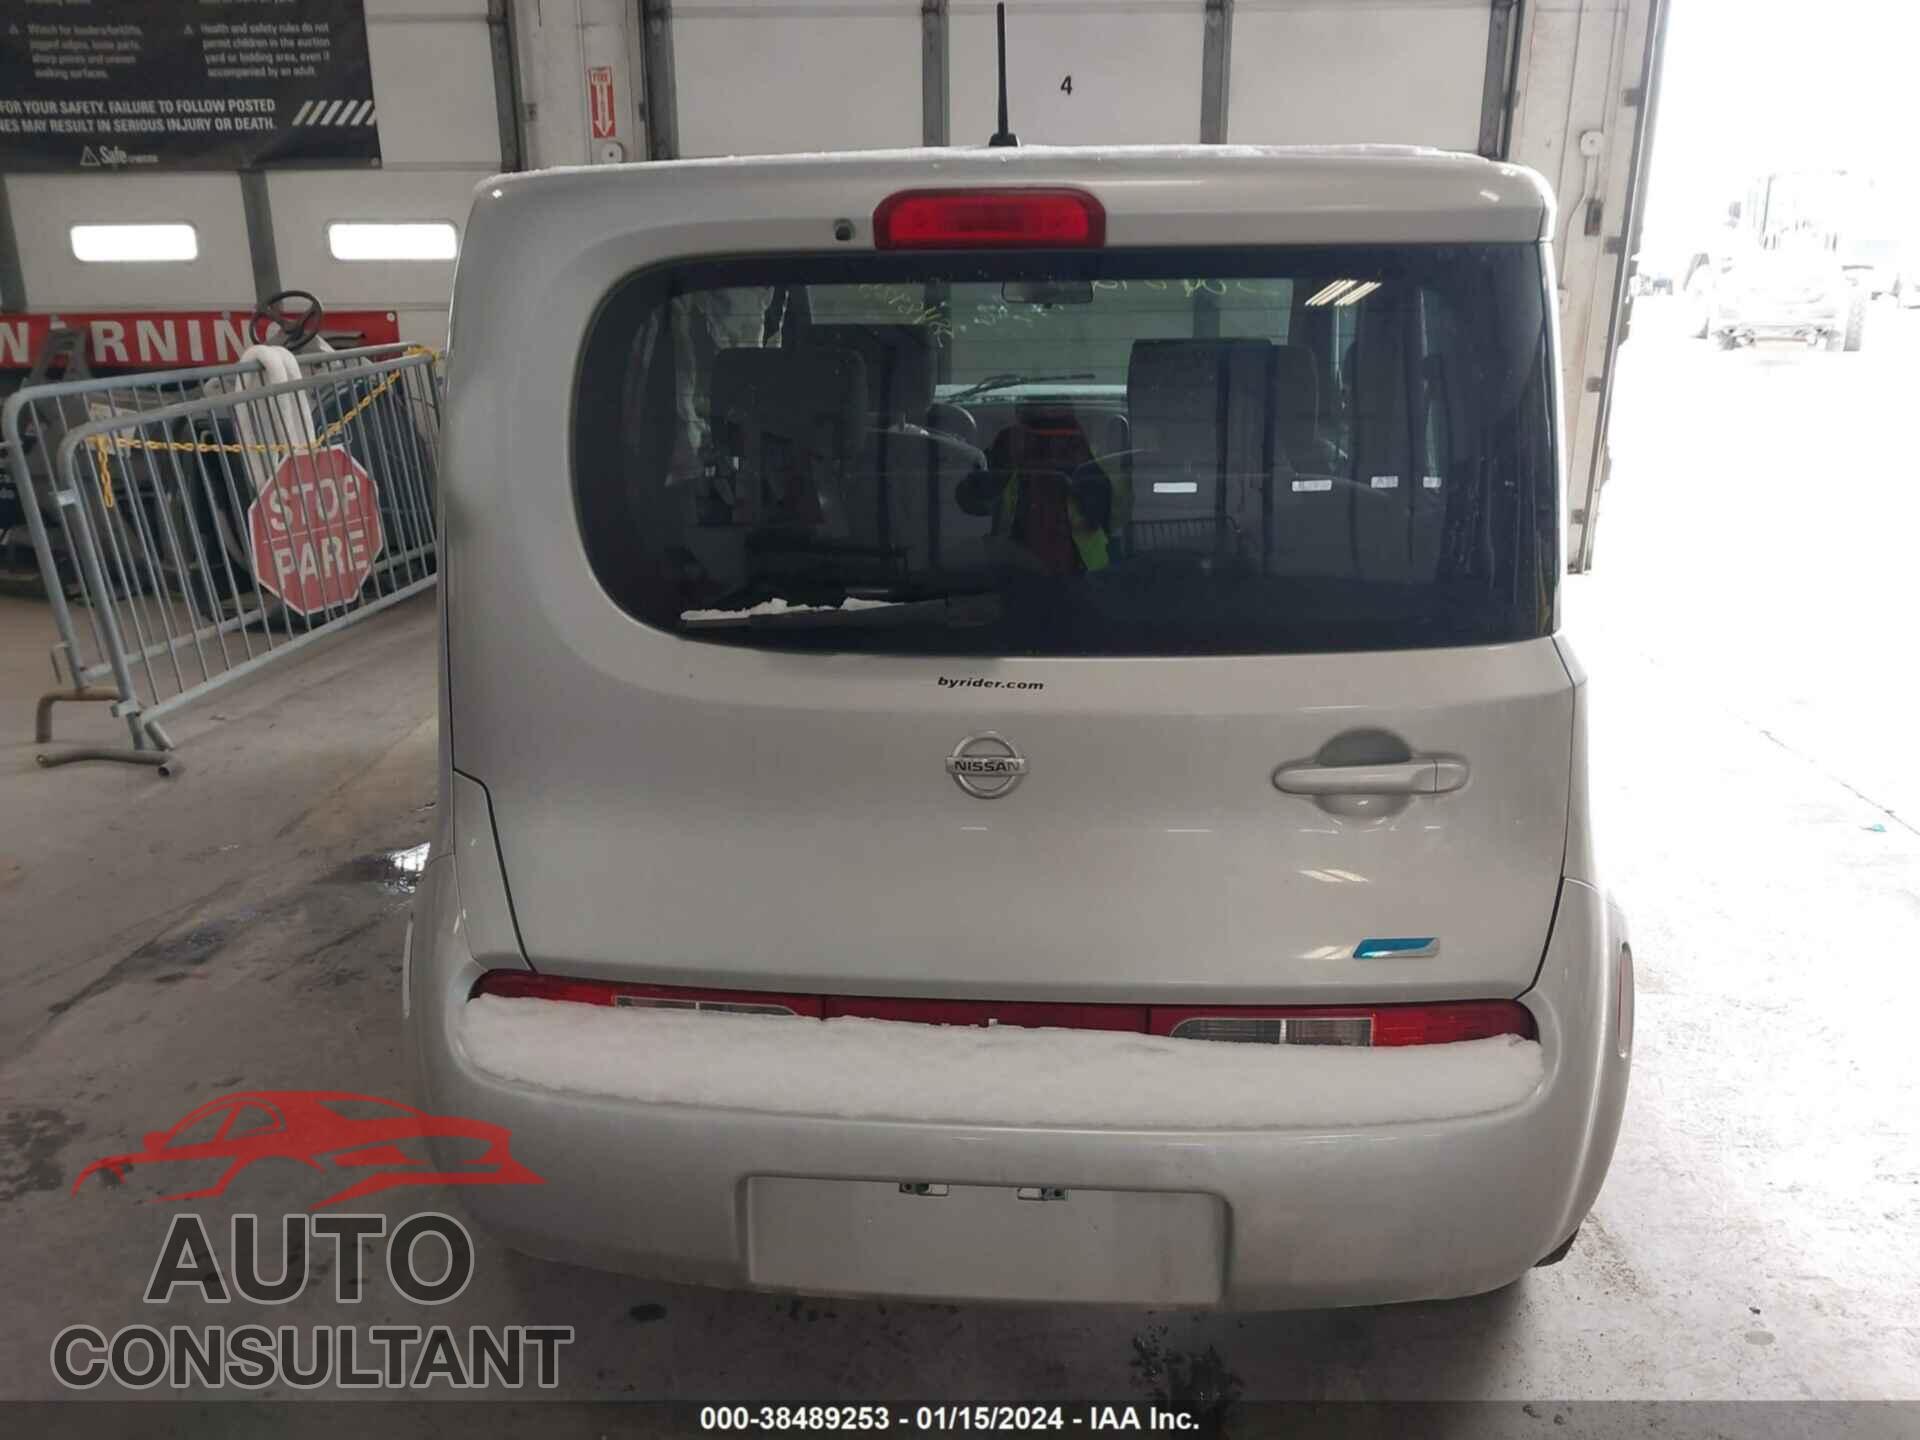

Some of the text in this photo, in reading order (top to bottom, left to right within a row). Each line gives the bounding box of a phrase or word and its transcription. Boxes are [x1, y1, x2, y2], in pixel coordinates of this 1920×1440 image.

[1060, 75, 1072, 95] 4
[23, 100, 58, 114] YOUR
[109, 100, 156, 114] FAILURE
[159, 99, 173, 113] TO
[176, 99, 225, 113] FOLLOW
[228, 99, 276, 113] POSTED
[21, 118, 47, 132] MAY
[49, 118, 94, 132] RESULT
[97, 118, 111, 132] IN
[114, 118, 165, 132] SERIOUS
[167, 117, 211, 131] INJURY
[214, 117, 233, 131] OR
[270, 474, 361, 530] STOP
[274, 529, 369, 590] PARE
[938, 676, 1044, 690] byrider.com
[954, 760, 1020, 773] NISSAN
